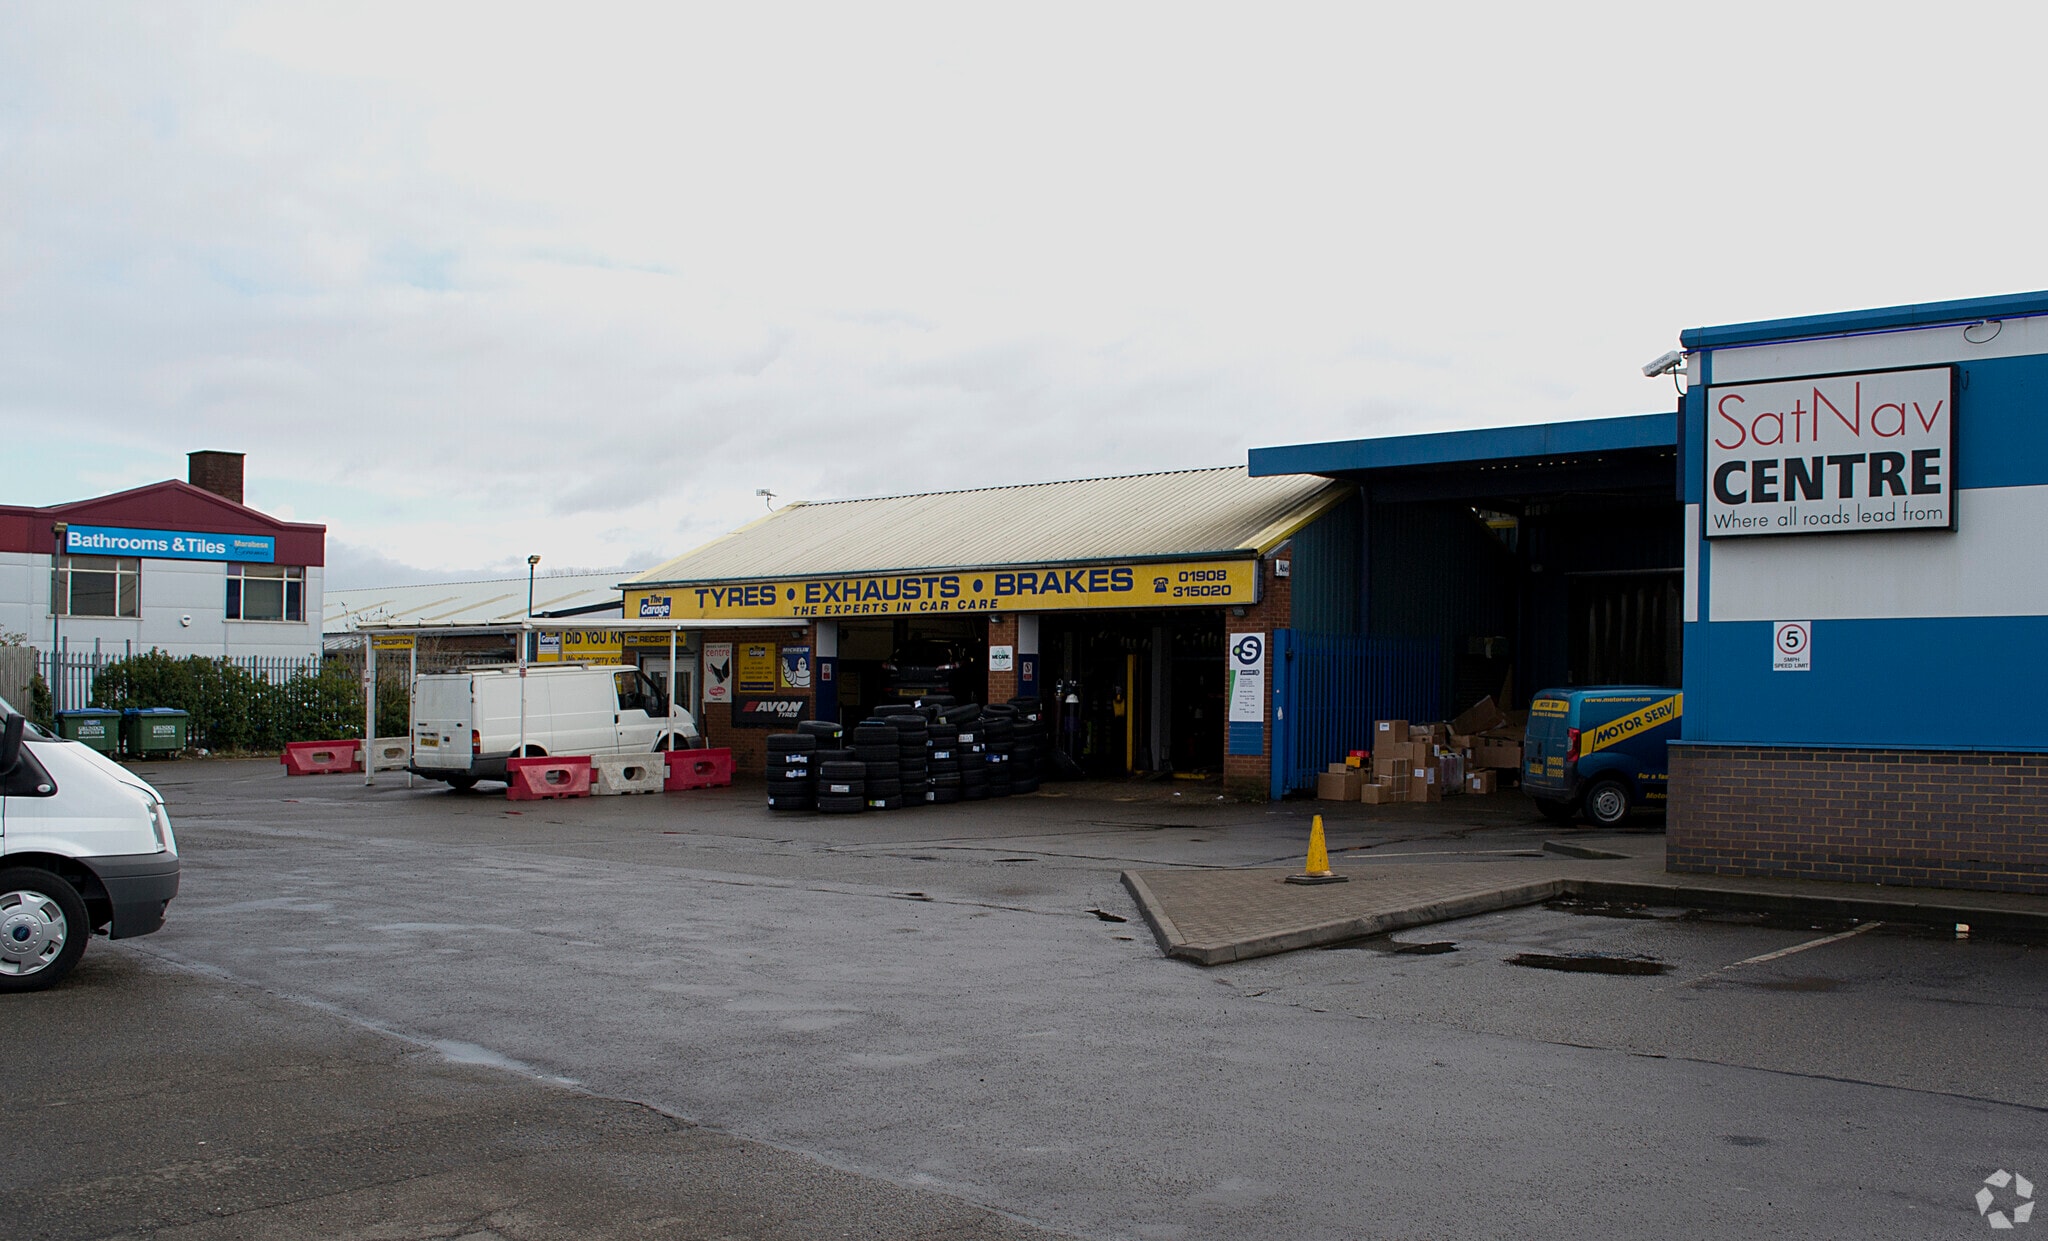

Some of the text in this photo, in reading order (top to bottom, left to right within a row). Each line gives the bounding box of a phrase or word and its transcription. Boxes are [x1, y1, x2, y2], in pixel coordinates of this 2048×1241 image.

[1714, 381, 1944, 450] SatNav
[1712, 448, 1942, 505] CENTRE
[1714, 501, 1943, 529] Where all roads lead from
[67, 532, 226, 554] Bathrooms & Tiles
[1178, 570, 1227, 583] 01908
[695, 568, 1134, 608] TYRES EXHAUSTS BRAKES
[1173, 585, 1231, 598] 315020
[650, 594, 663, 604] The
[793, 598, 998, 616] THE EXPERTS IN CAR CARE
[640, 604, 670, 617] Garage
[565, 632, 582, 645] DID
[586, 631, 607, 645] YOU
[1786, 631, 1798, 648] 5
[706, 649, 730, 657] centre
[756, 702, 803, 712] AVON
[1596, 703, 1673, 744] MOTOR SERV
